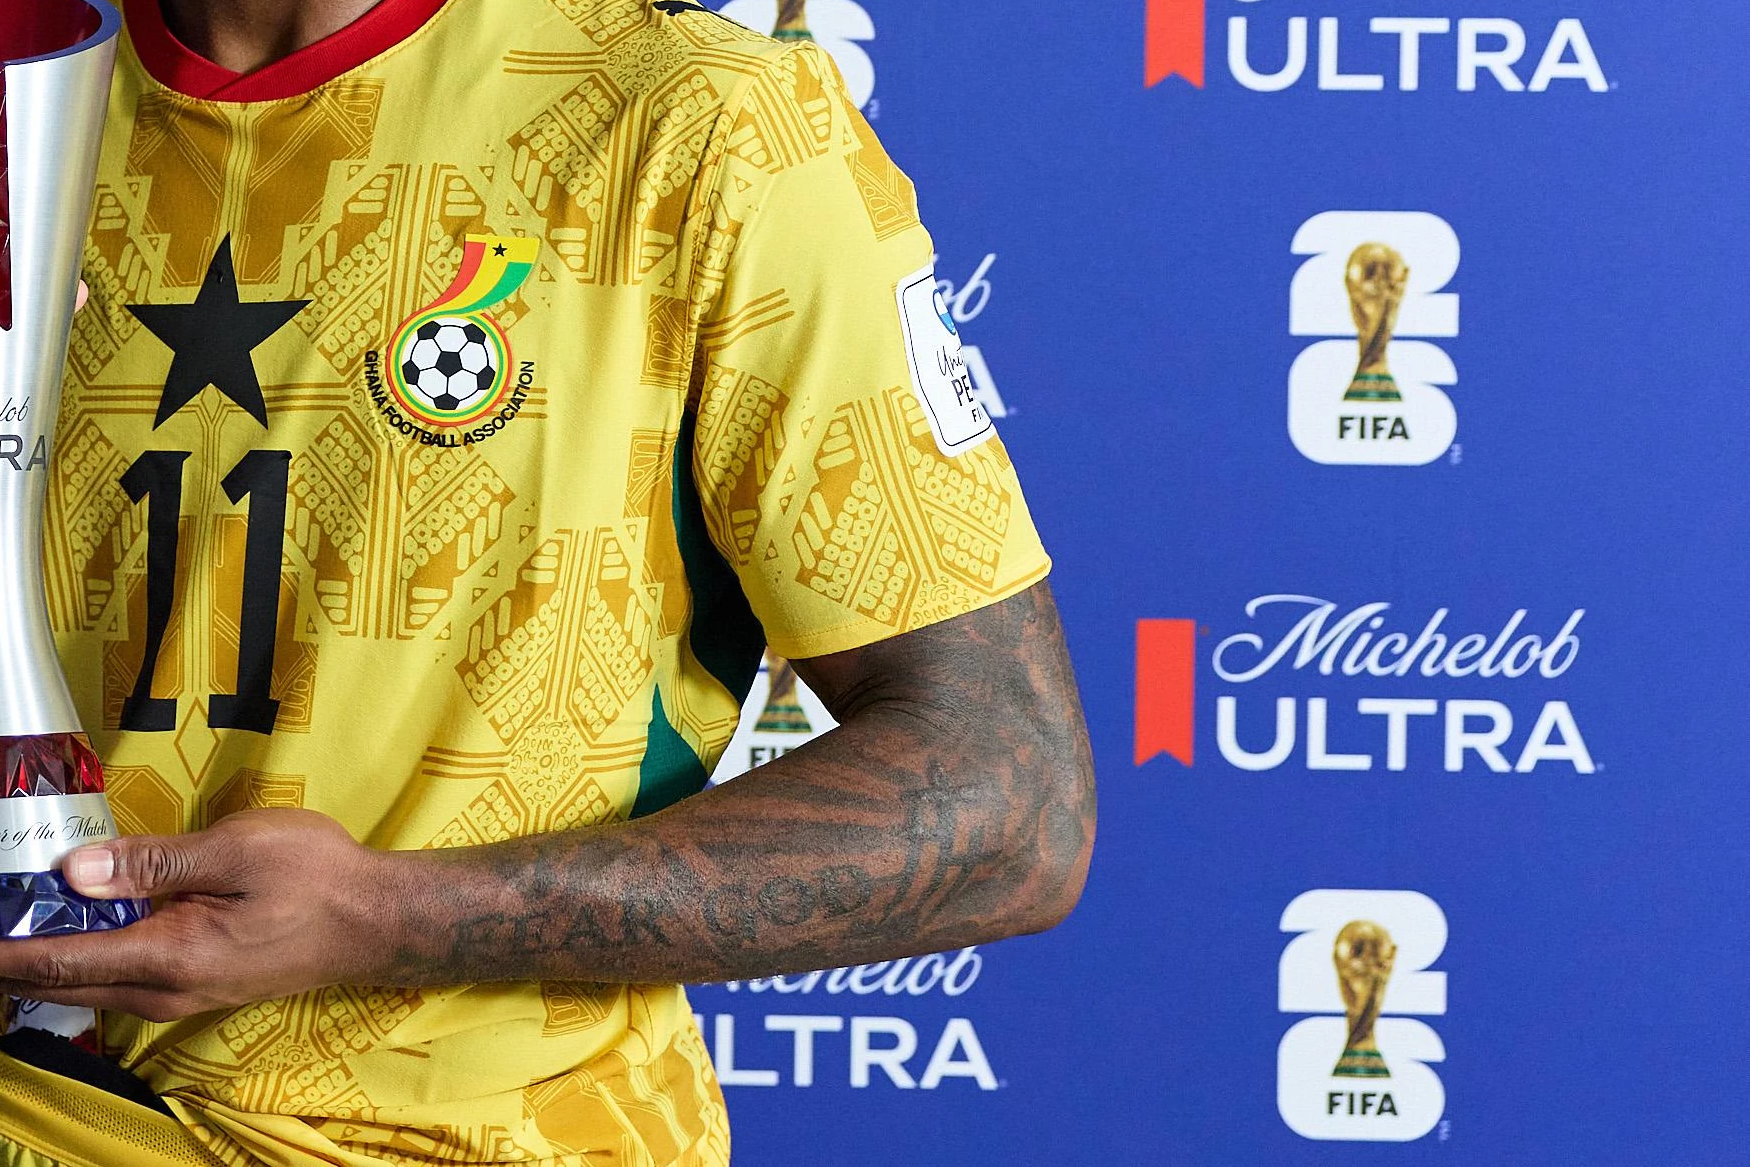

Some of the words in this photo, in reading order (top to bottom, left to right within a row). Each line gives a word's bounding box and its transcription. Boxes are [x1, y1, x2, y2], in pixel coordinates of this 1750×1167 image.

[1228, 17, 1608, 92] ULTRA
[365, 350, 388, 409] GHANA
[381, 406, 462, 448] FOOTBALL
[463, 360, 535, 446] ASSOCIATION
[1339, 415, 1411, 440] FIFA
[118, 449, 293, 736] 11
[1213, 595, 1585, 682] Michelob
[750, 746, 796, 769] FI
[1217, 696, 1595, 773] ULTRA
[8, 822, 34, 850] of
[63, 815, 108, 841] Match
[692, 1013, 1000, 1090] LTRA
[1328, 1091, 1399, 1116] FIFA
